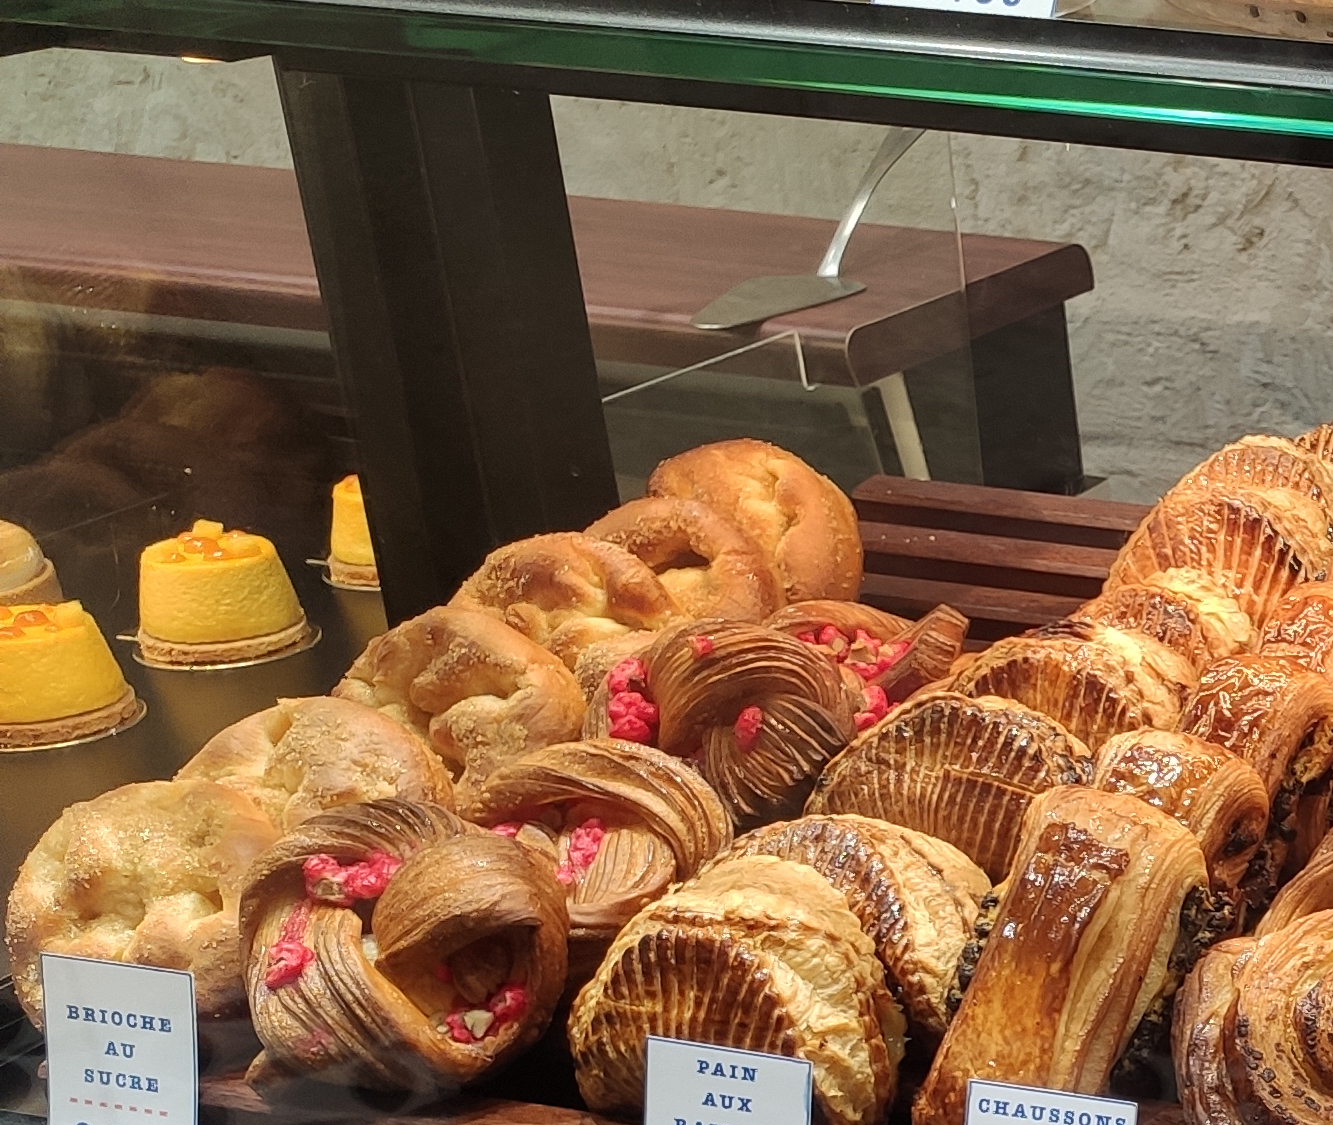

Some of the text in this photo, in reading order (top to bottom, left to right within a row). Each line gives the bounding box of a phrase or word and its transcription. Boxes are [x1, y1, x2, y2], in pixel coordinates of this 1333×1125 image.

[66, 1005, 171, 1033] BRIOCHE
[105, 1041, 135, 1058] AU
[84, 1069, 159, 1093] SUCRE
[697, 1060, 758, 1082] PAIN
[702, 1092, 752, 1112] AUX
